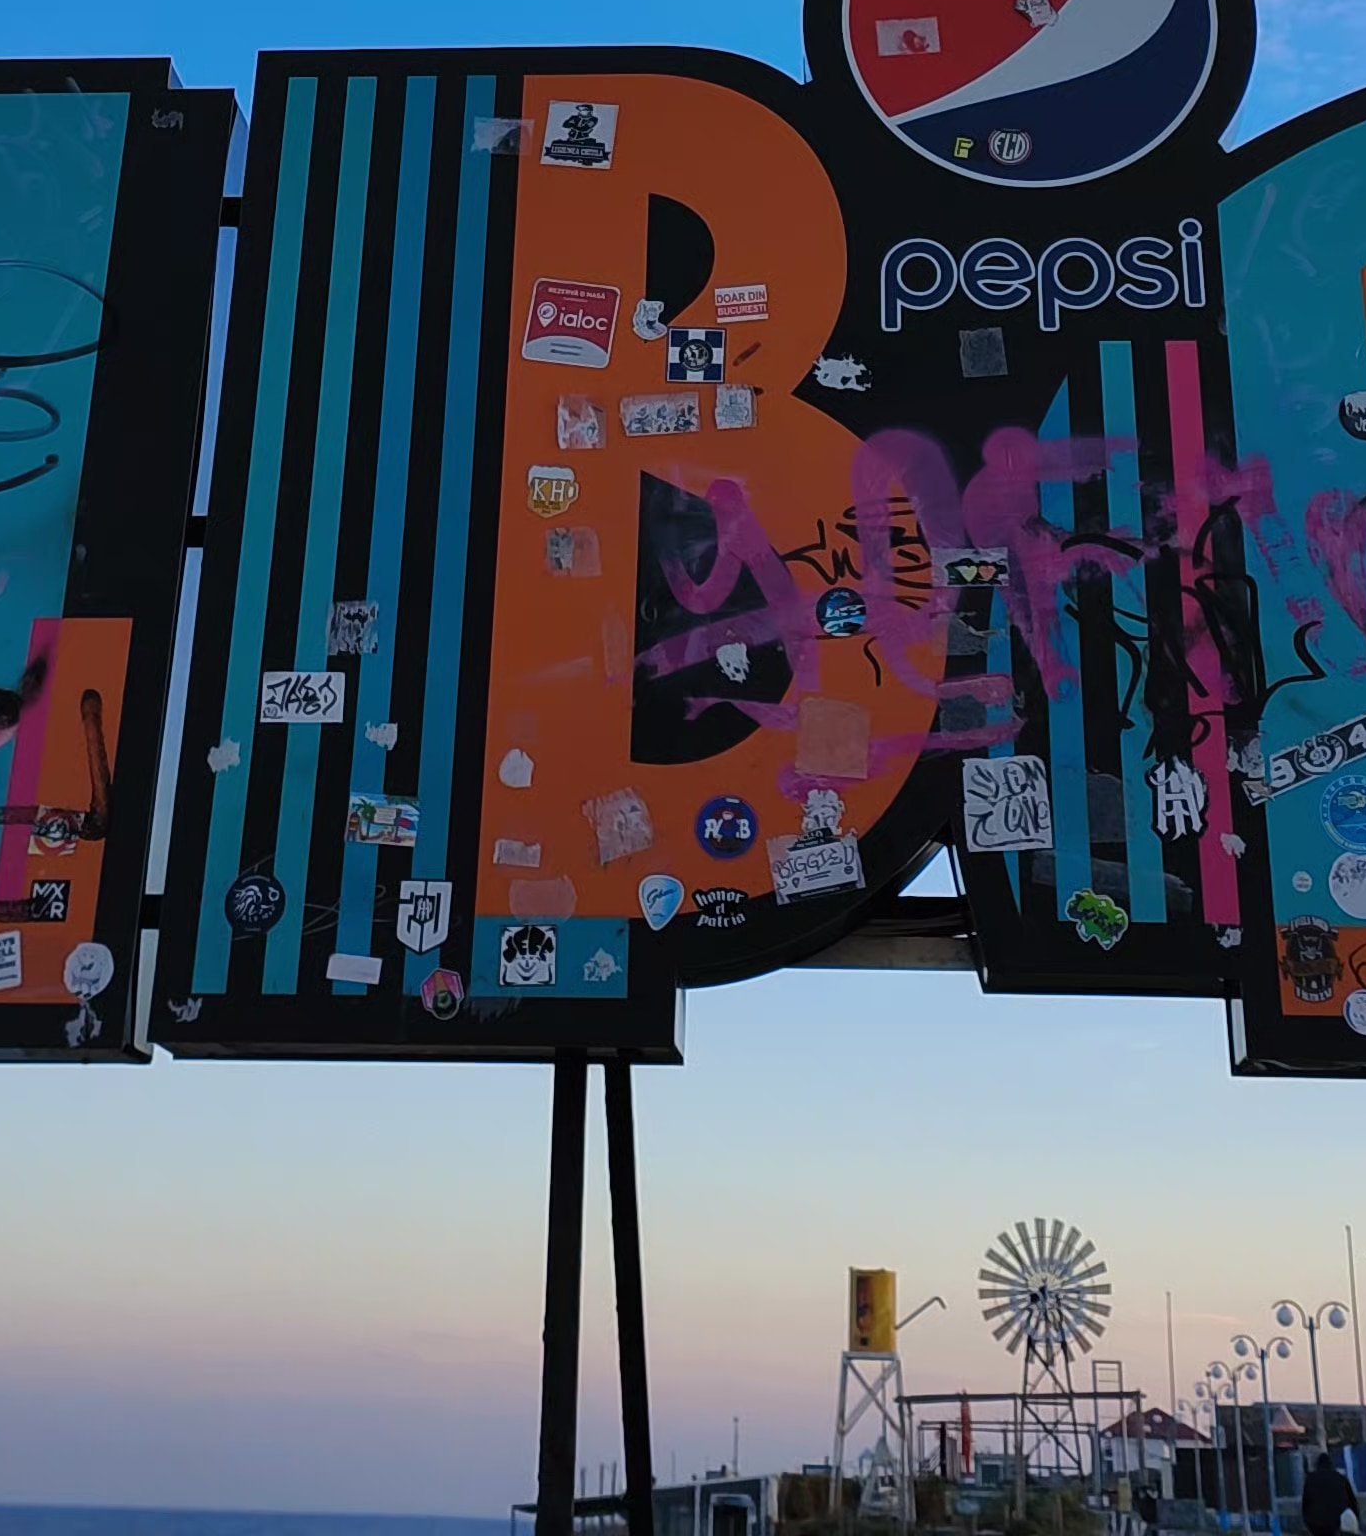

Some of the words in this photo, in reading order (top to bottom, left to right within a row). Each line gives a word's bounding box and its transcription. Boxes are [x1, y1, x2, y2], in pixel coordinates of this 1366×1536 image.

[880, 217, 1207, 332] pepsi
[716, 291, 745, 305] DOAR
[748, 289, 766, 302] DIN
[558, 305, 609, 332] ialoc
[532, 478, 566, 503] KH
